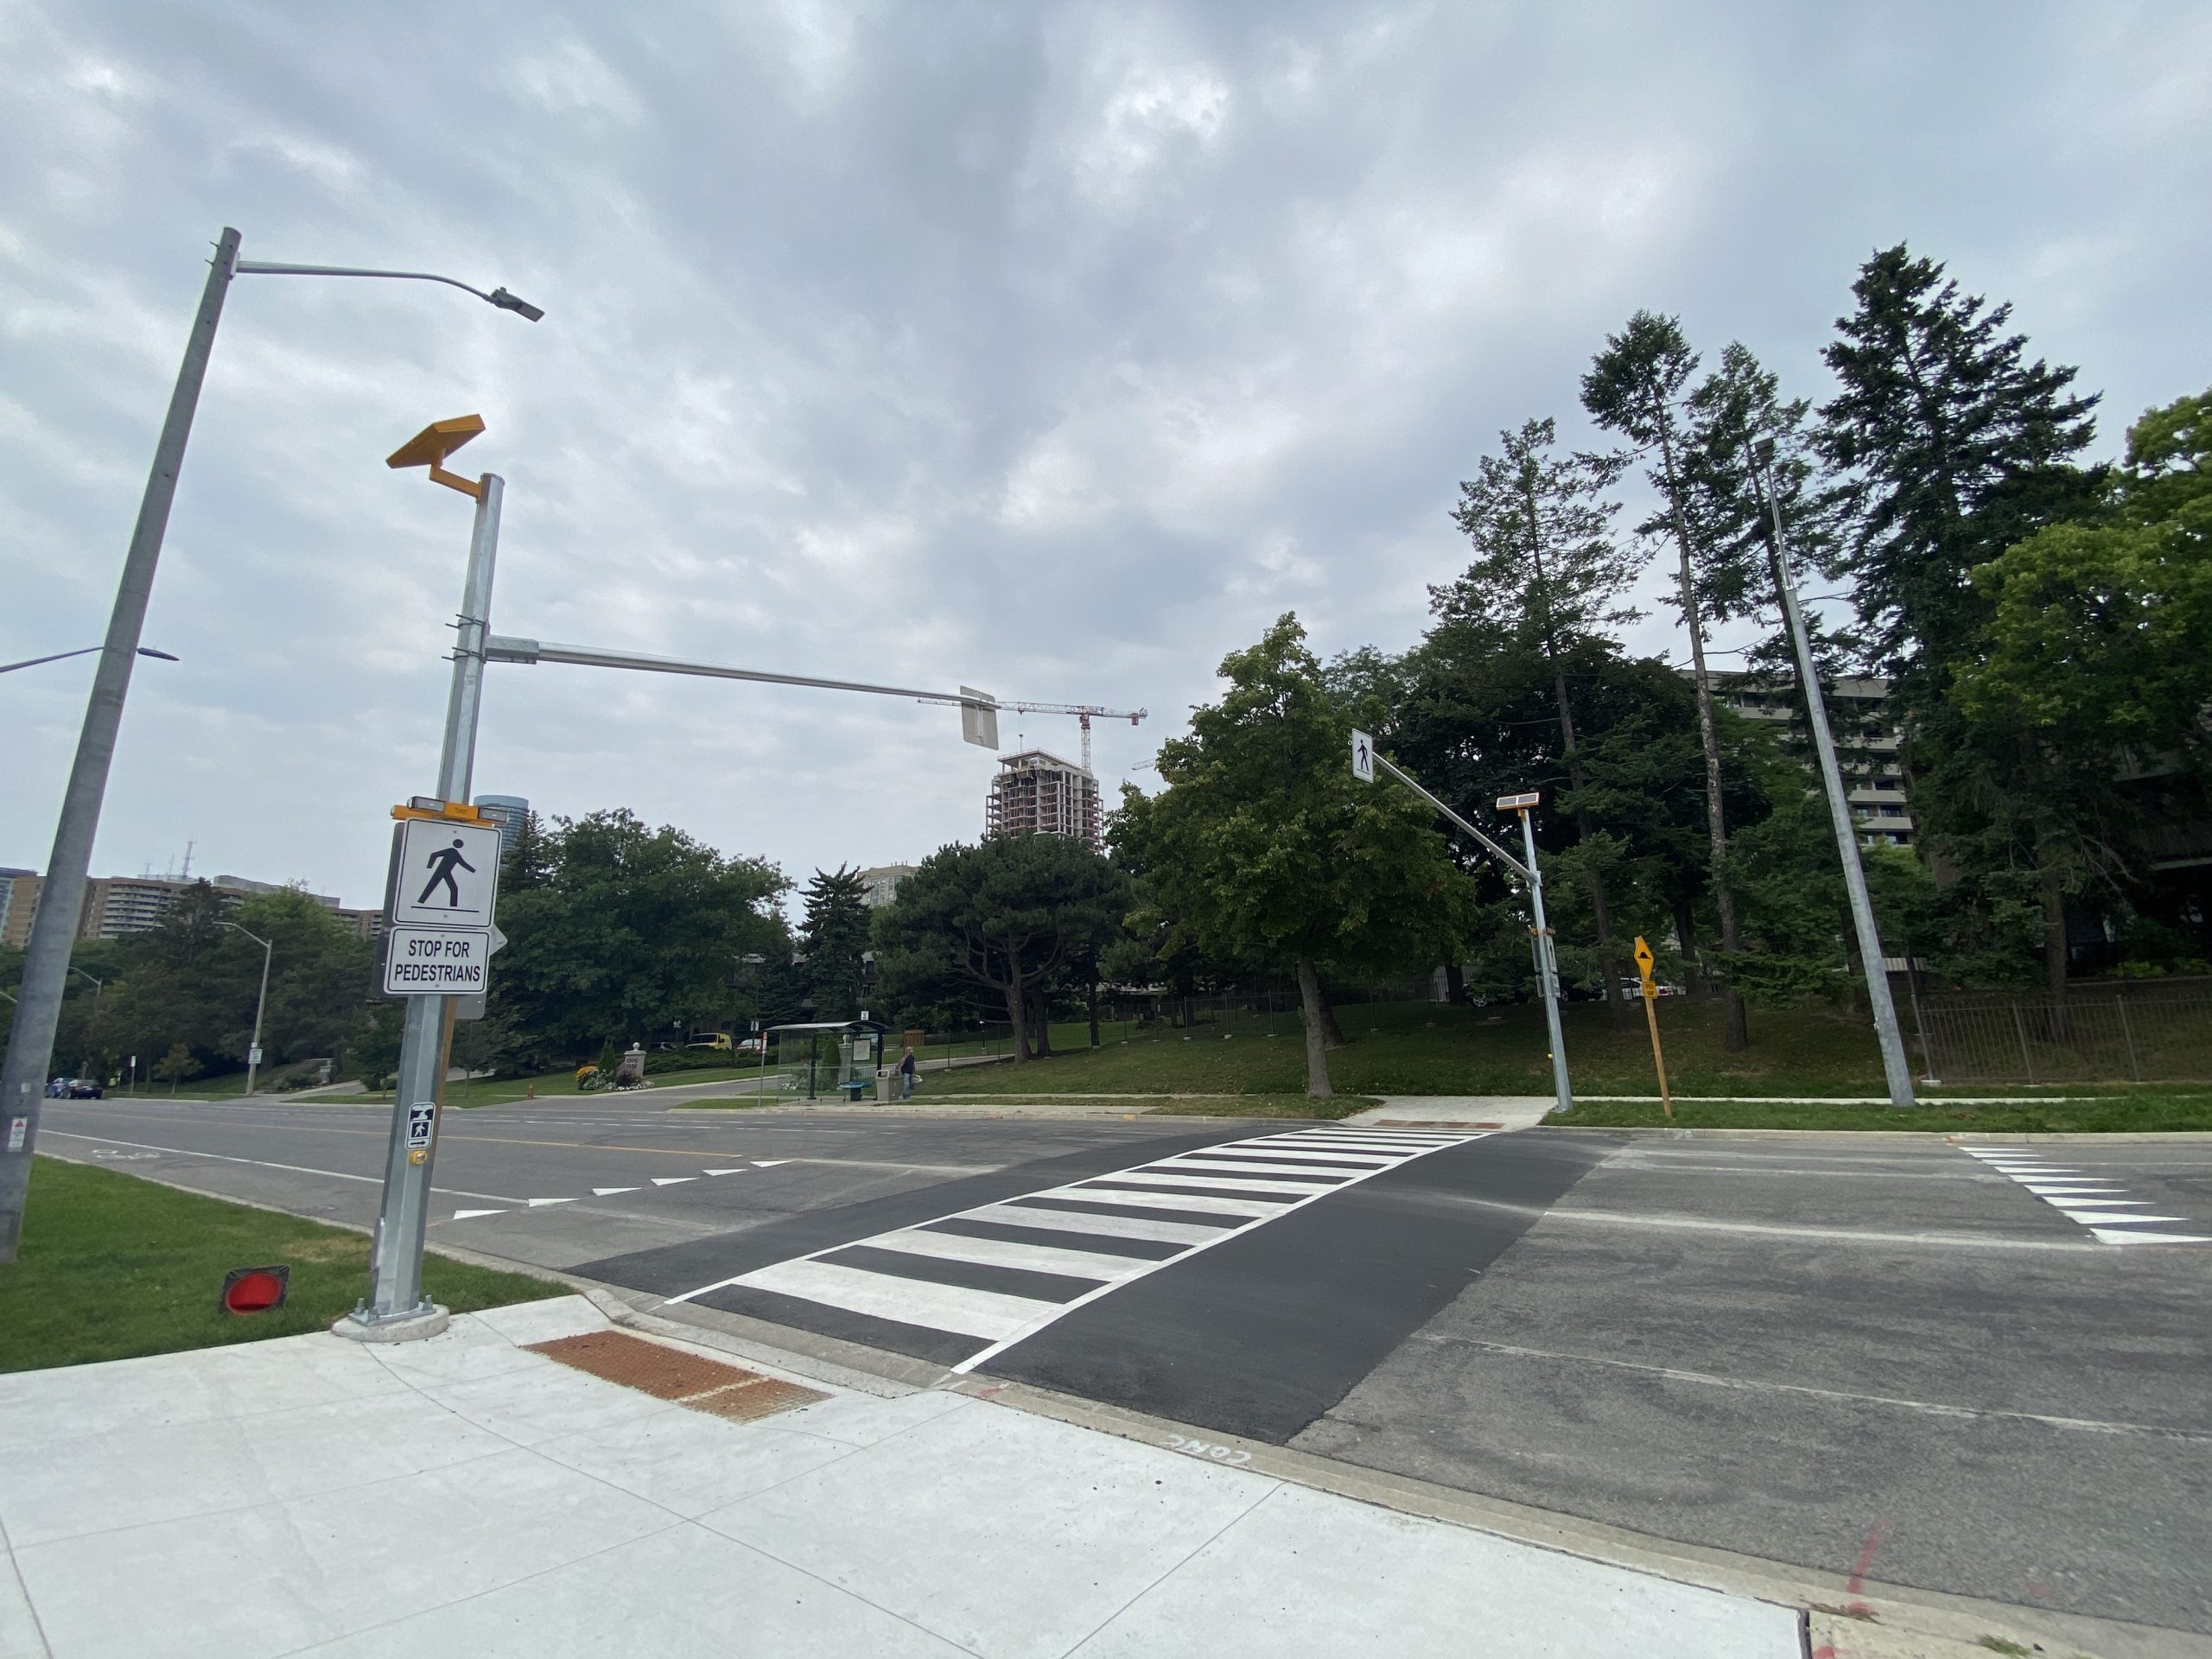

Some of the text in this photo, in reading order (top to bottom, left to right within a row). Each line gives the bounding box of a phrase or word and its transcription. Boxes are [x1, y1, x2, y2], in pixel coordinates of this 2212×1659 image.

[408, 939, 470, 958] STOP FOR
[394, 963, 480, 982] PEDESTRIANS
